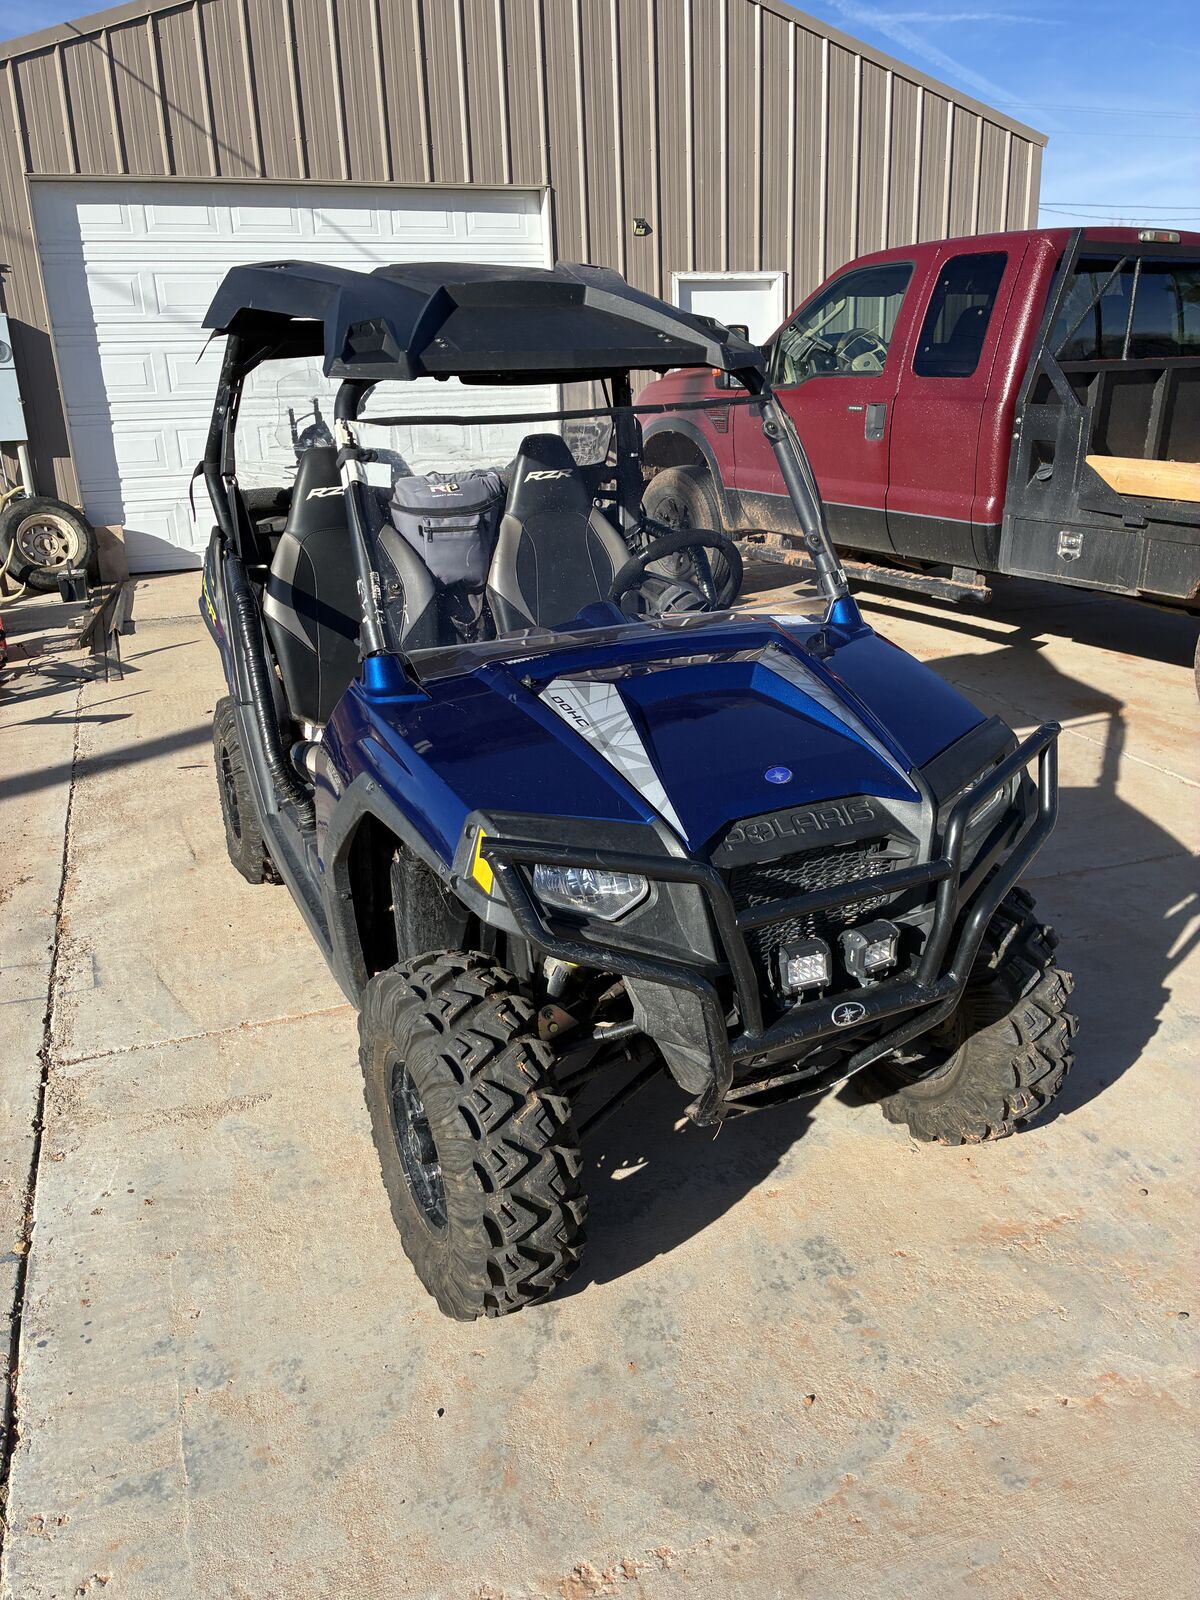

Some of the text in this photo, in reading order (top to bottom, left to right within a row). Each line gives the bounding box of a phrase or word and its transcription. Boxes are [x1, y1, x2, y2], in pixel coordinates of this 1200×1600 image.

[524, 469, 573, 483] RZR
[305, 486, 345, 501] RZ
[551, 695, 590, 728] DOHC
[722, 800, 876, 852] POLARIS
